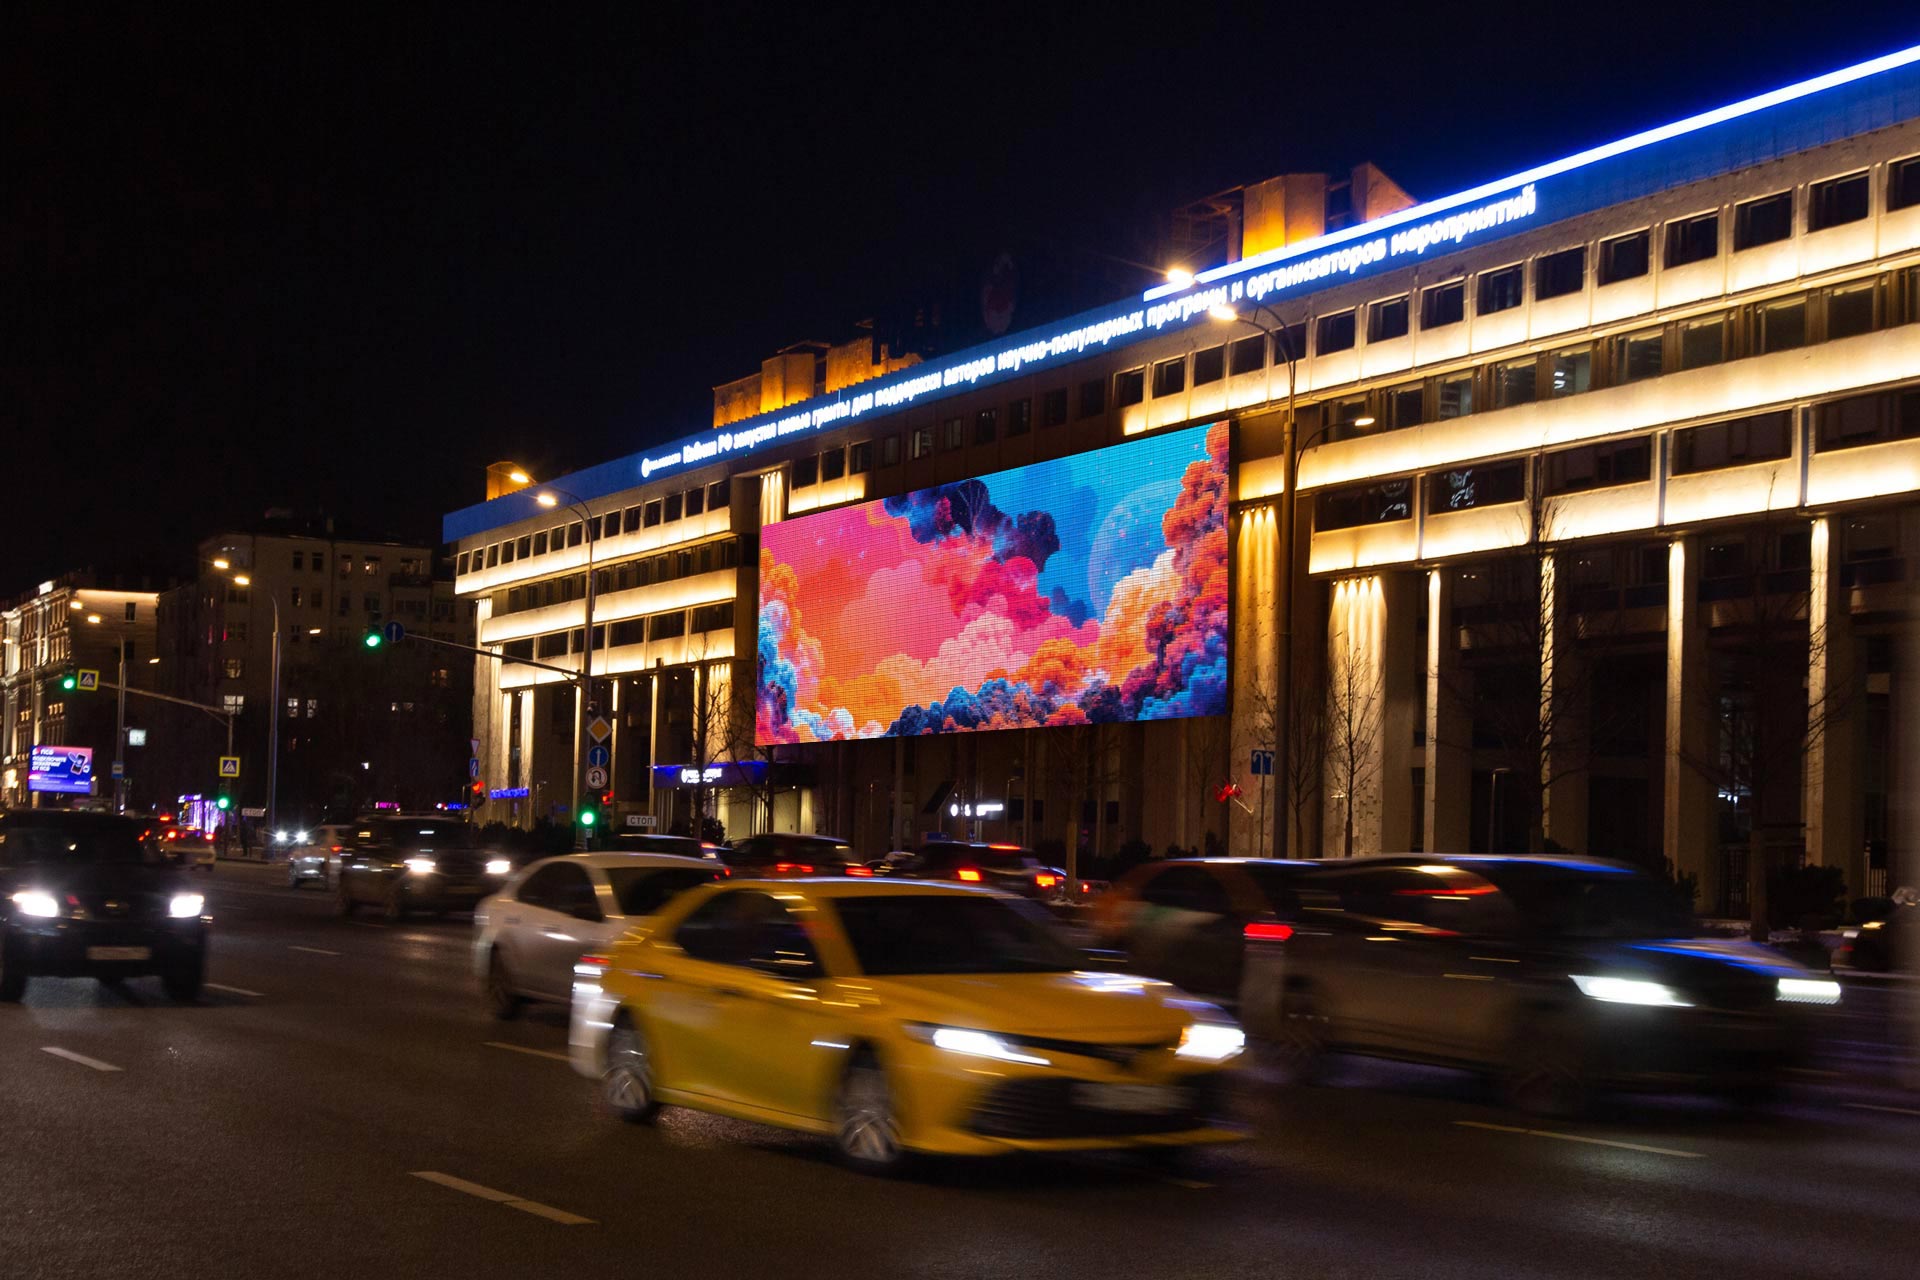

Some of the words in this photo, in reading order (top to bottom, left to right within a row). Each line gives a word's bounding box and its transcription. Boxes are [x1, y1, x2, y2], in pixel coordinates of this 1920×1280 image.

[718, 433, 734, 453] РФ
[778, 412, 811, 435] новые
[812, 400, 850, 428] гранты
[851, 392, 873, 417] для
[875, 374, 942, 407] поддержки
[944, 355, 996, 383] авторов
[998, 311, 1143, 370] научно-популярных
[1147, 285, 1228, 329] программ
[1232, 280, 1243, 302] и
[1247, 238, 1386, 300] организаторов
[1391, 184, 1536, 256] мероприятий
[630, 816, 653, 825] СТОП
